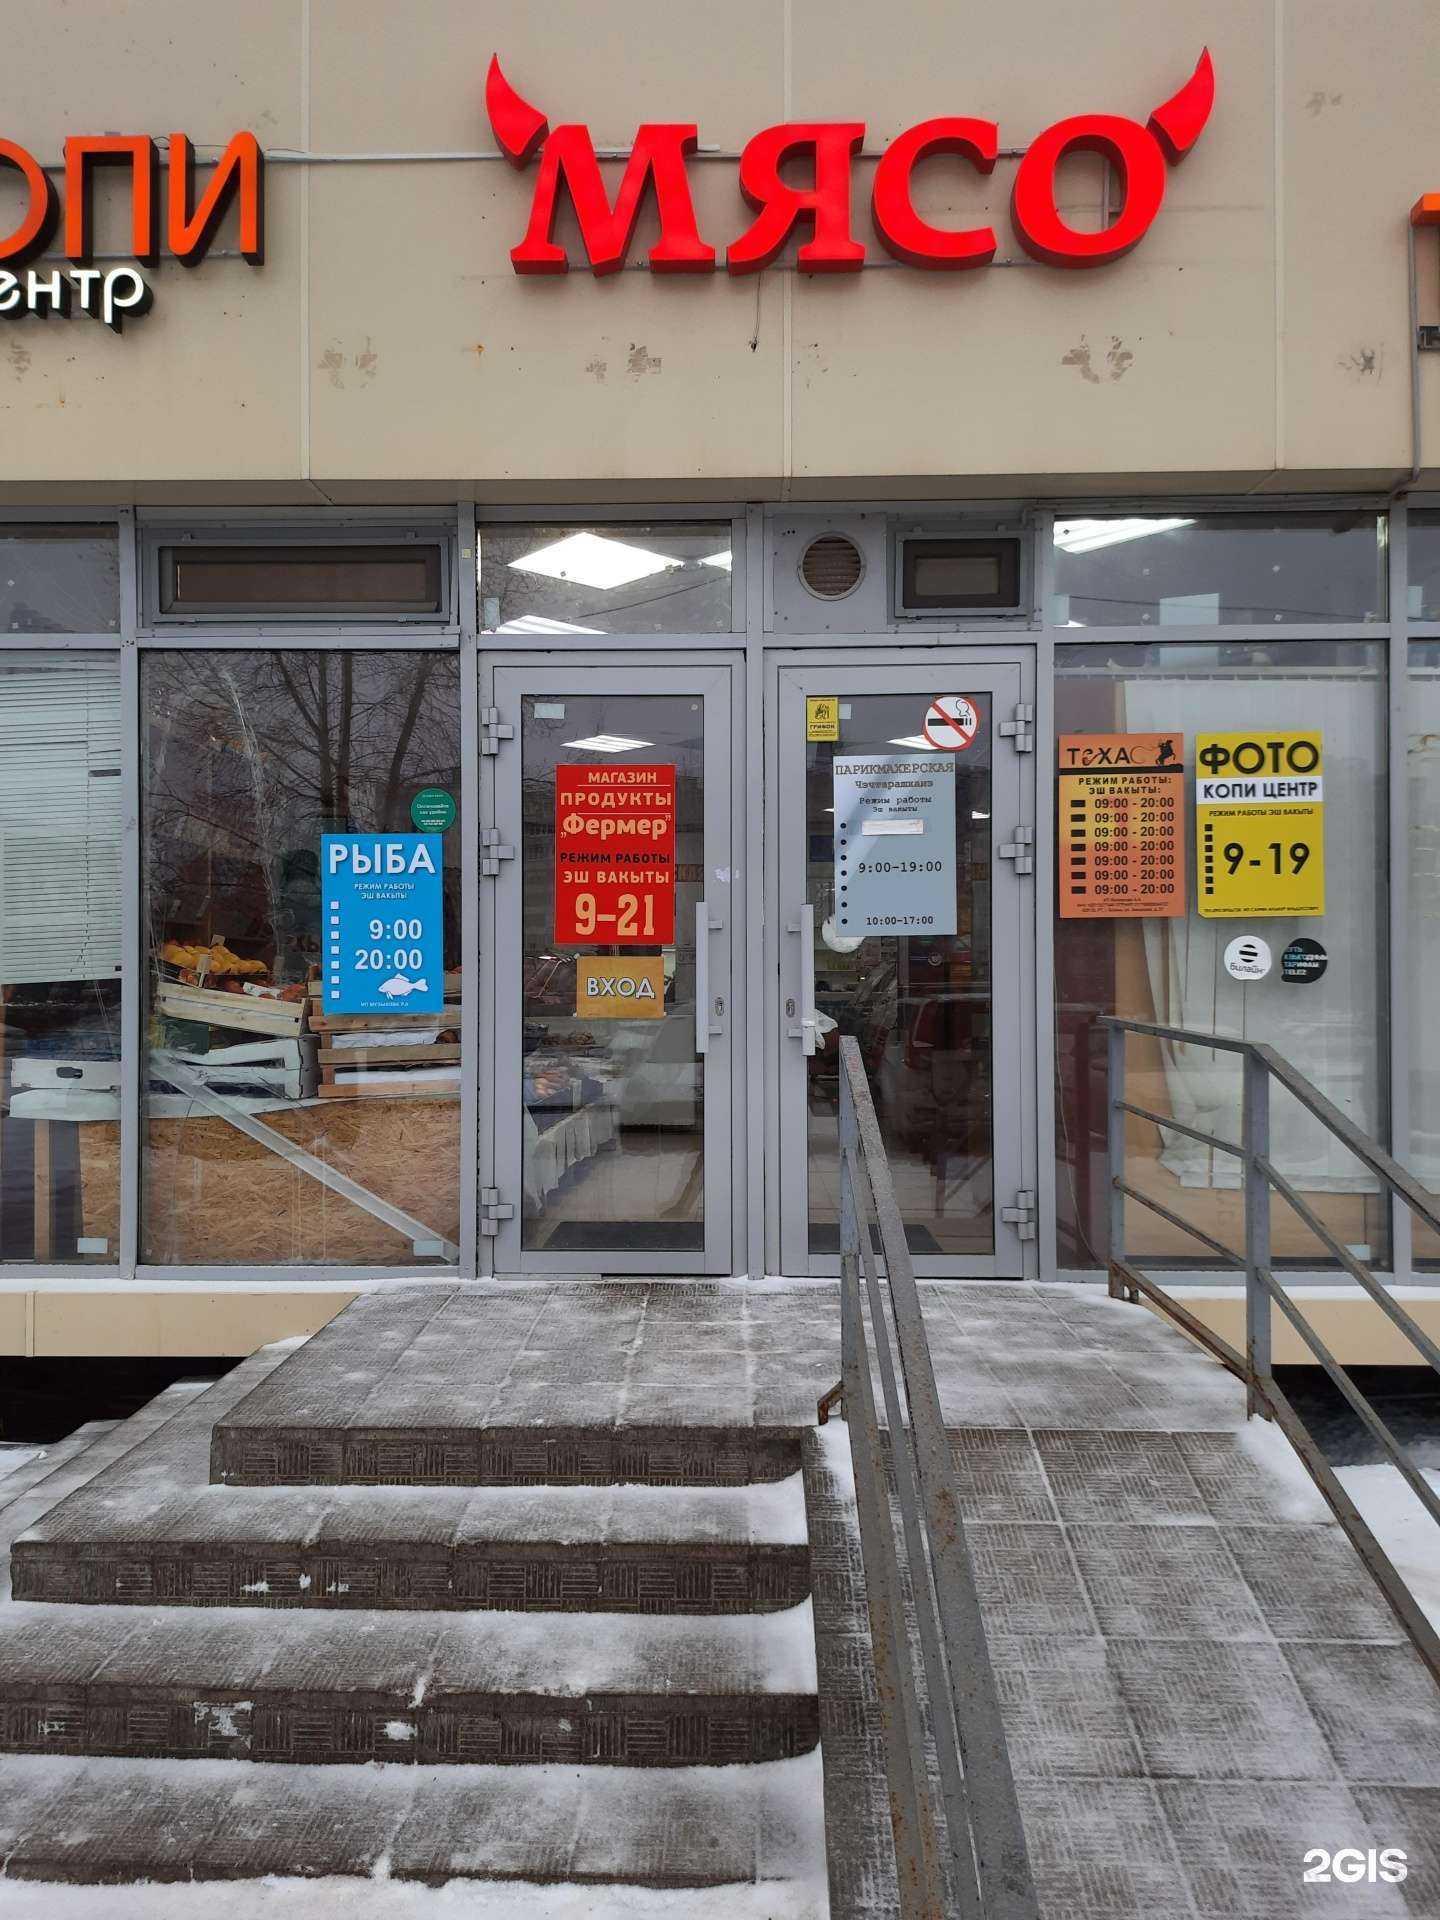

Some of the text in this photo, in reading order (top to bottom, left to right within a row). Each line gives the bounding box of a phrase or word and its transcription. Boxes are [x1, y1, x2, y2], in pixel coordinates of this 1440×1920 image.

[510, 114, 1167, 275] МЯСО
[1199, 740, 1319, 775] ФОТО
[835, 762, 954, 776] ПАРИКМАХЕРСКАЯ
[588, 772, 657, 784] МАГАЗИН
[1078, 776, 1172, 785] РЕЖИМ РАБОТЫ:
[1088, 786, 1161, 795] ЭШ ВАКЫТЫ:
[1203, 782, 1318, 801] КОПИ ЦЕНТР
[560, 792, 672, 808] ПРОДУКТЫ
[859, 795, 932, 805] Режим работы
[1094, 799, 1128, 809] 09:00
[1140, 798, 1174, 808] 20:00
[1094, 813, 1128, 823] 09:00
[1140, 812, 1174, 823] 20:00
[1094, 827, 1128, 837] 09:00
[1140, 826, 1174, 837] 20:00
[1094, 842, 1128, 852] 09:00
[1140, 841, 1174, 851] 20:00
[329, 843, 436, 874] РЫБА
[560, 852, 670, 864] РЕЖИМ РАБОТЫ
[1094, 856, 1128, 866] 09:00
[1140, 855, 1174, 866] 20:00
[858, 860, 943, 873] 9:00-19:00
[563, 871, 669, 884] ЭШ ВАКЫТЫ
[1094, 870, 1128, 880] 09:00
[1140, 869, 1174, 880] 20:00
[1094, 885, 1128, 894] 09:00
[1140, 884, 1174, 894] 20:00
[376, 892, 407, 900] ВАКЫТЫ
[575, 893, 655, 937] 9-21
[866, 916, 934, 926] 10:00-17:00
[369, 919, 422, 940] 9:00
[354, 949, 423, 970] 20:00
[586, 977, 655, 999] ВХОД
